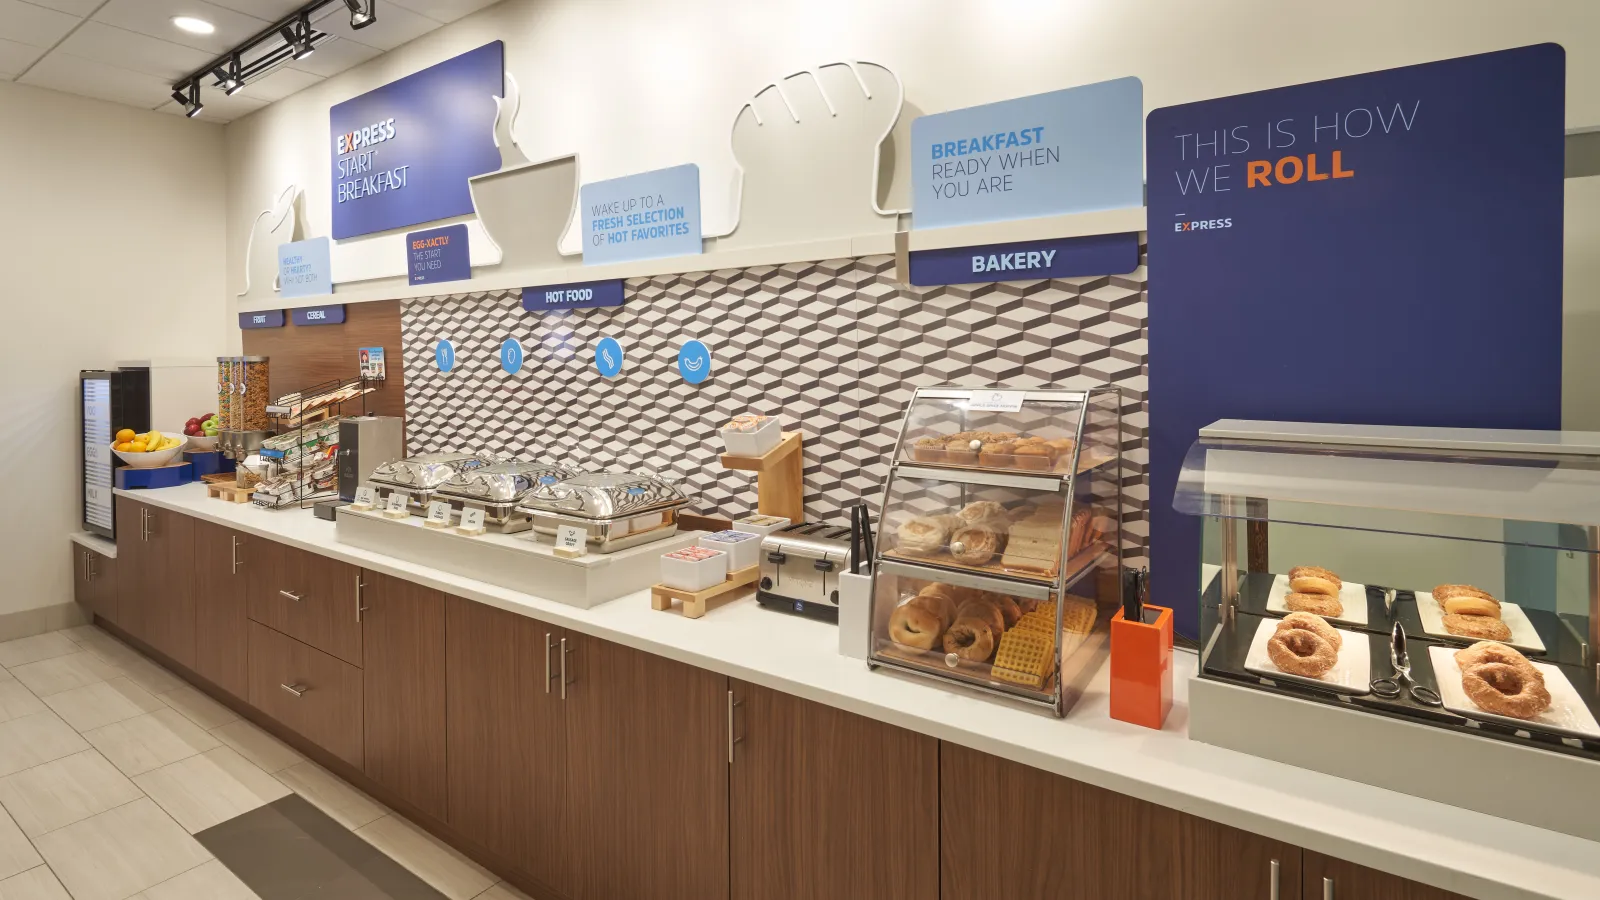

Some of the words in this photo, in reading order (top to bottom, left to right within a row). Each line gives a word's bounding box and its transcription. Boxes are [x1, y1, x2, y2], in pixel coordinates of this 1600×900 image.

[337, 117, 396, 155] EXPRESS
[1174, 125, 1250, 161] THIS
[1267, 118, 1296, 149] IS
[1314, 100, 1420, 143] HOW
[931, 126, 1045, 160] BREAKFAST
[932, 156, 992, 180] READY
[998, 146, 1060, 170] WHEN
[1175, 164, 1231, 196] WE
[1247, 150, 1354, 188] ROLL
[338, 165, 409, 203] BREAKFAST
[932, 181, 970, 200] YOU
[976, 175, 1013, 195] ARE
[592, 202, 619, 217] WAKE
[622, 198, 637, 212] UP
[640, 195, 653, 209] TO
[656, 194, 665, 206] A
[592, 216, 624, 231] FRESH
[626, 207, 685, 227] SELECTION
[1174, 217, 1232, 232] EXPRESS
[412, 236, 449, 250] EGG-XACTLY
[592, 234, 605, 246] OF
[607, 231, 628, 244] HOT
[631, 222, 690, 241] FAVORITES
[283, 255, 303, 266] HEALTHY
[413, 251, 424, 261] THE
[425, 248, 441, 260] START
[414, 262, 425, 271] YOU
[426, 260, 442, 270] NEED
[972, 250, 1057, 273] BAKERY
[545, 291, 564, 303] HOT
[566, 288, 593, 302] FOOD
[253, 315, 267, 324] FRUIT
[306, 310, 326, 320] CEREAL
